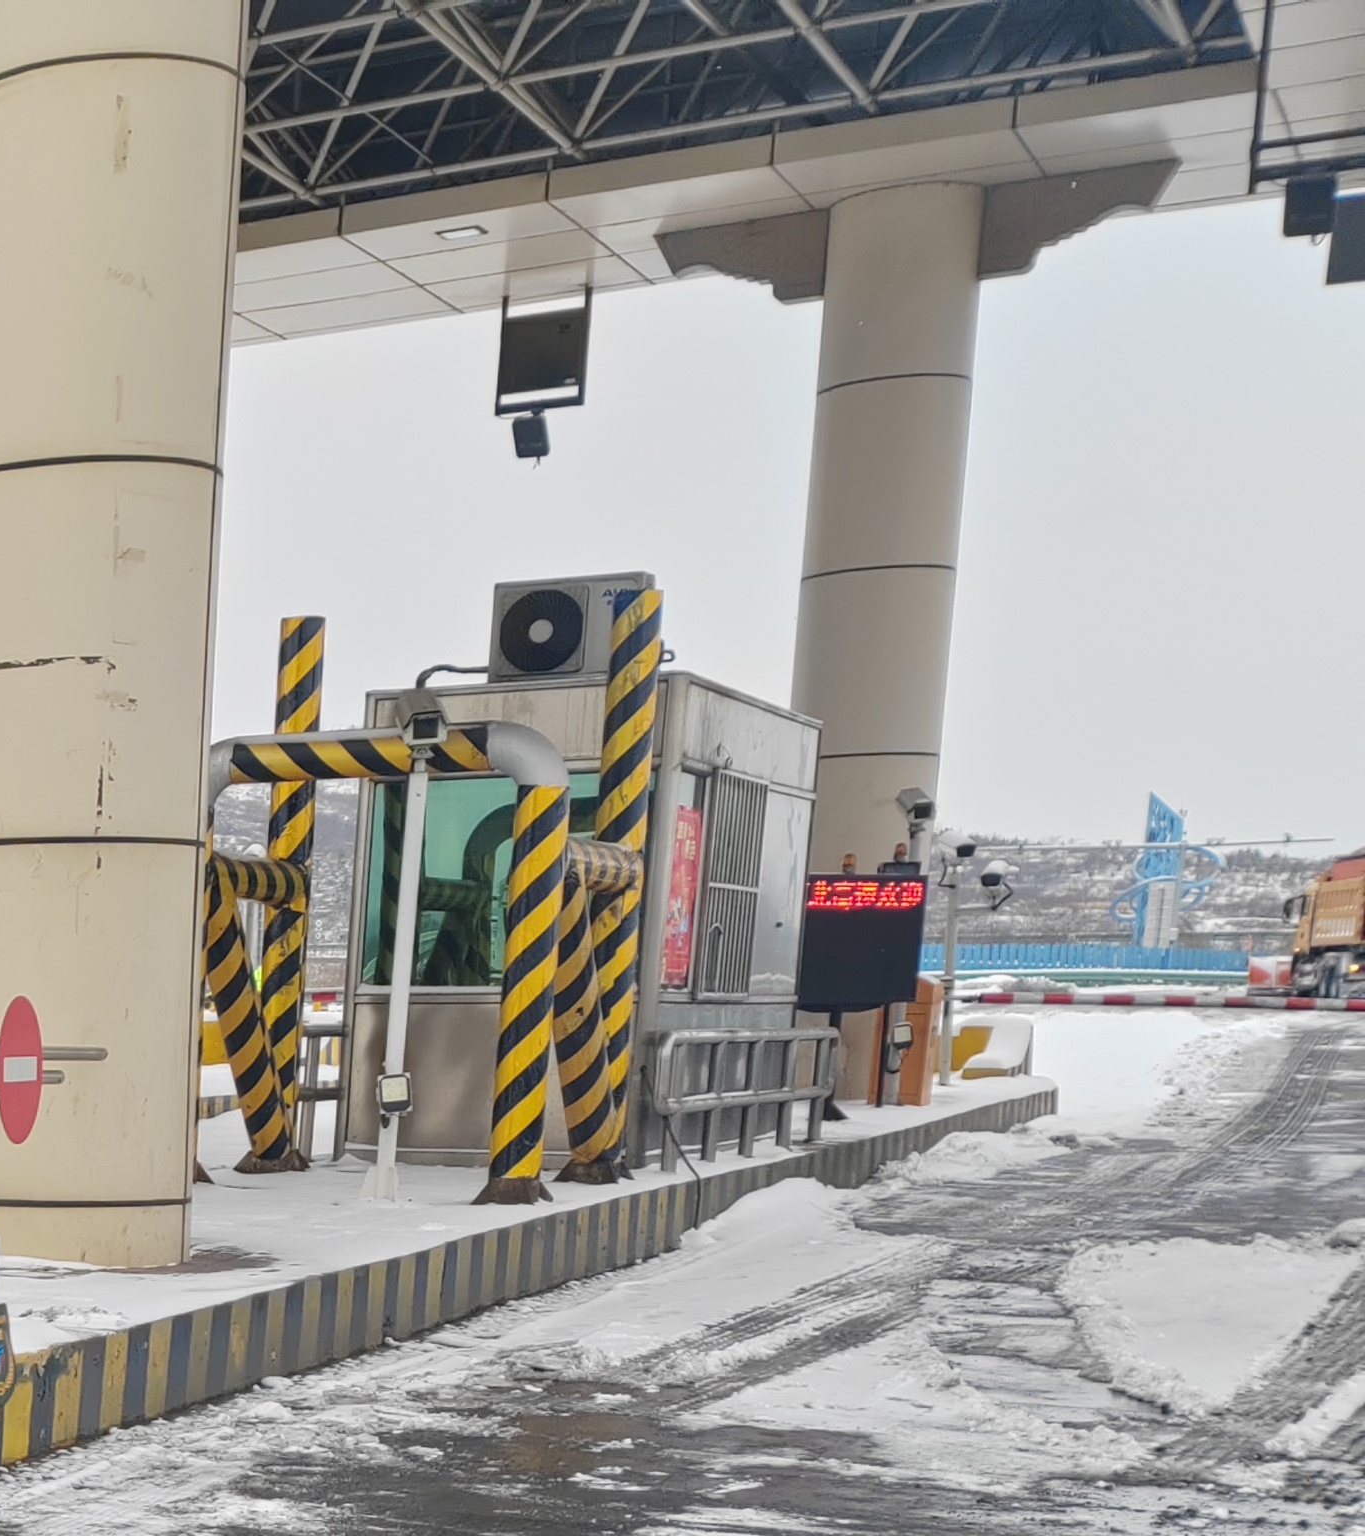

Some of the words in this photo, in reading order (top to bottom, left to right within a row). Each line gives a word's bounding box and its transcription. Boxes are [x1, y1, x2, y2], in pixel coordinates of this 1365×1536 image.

[806, 880, 924, 911] 北高速欢迎
